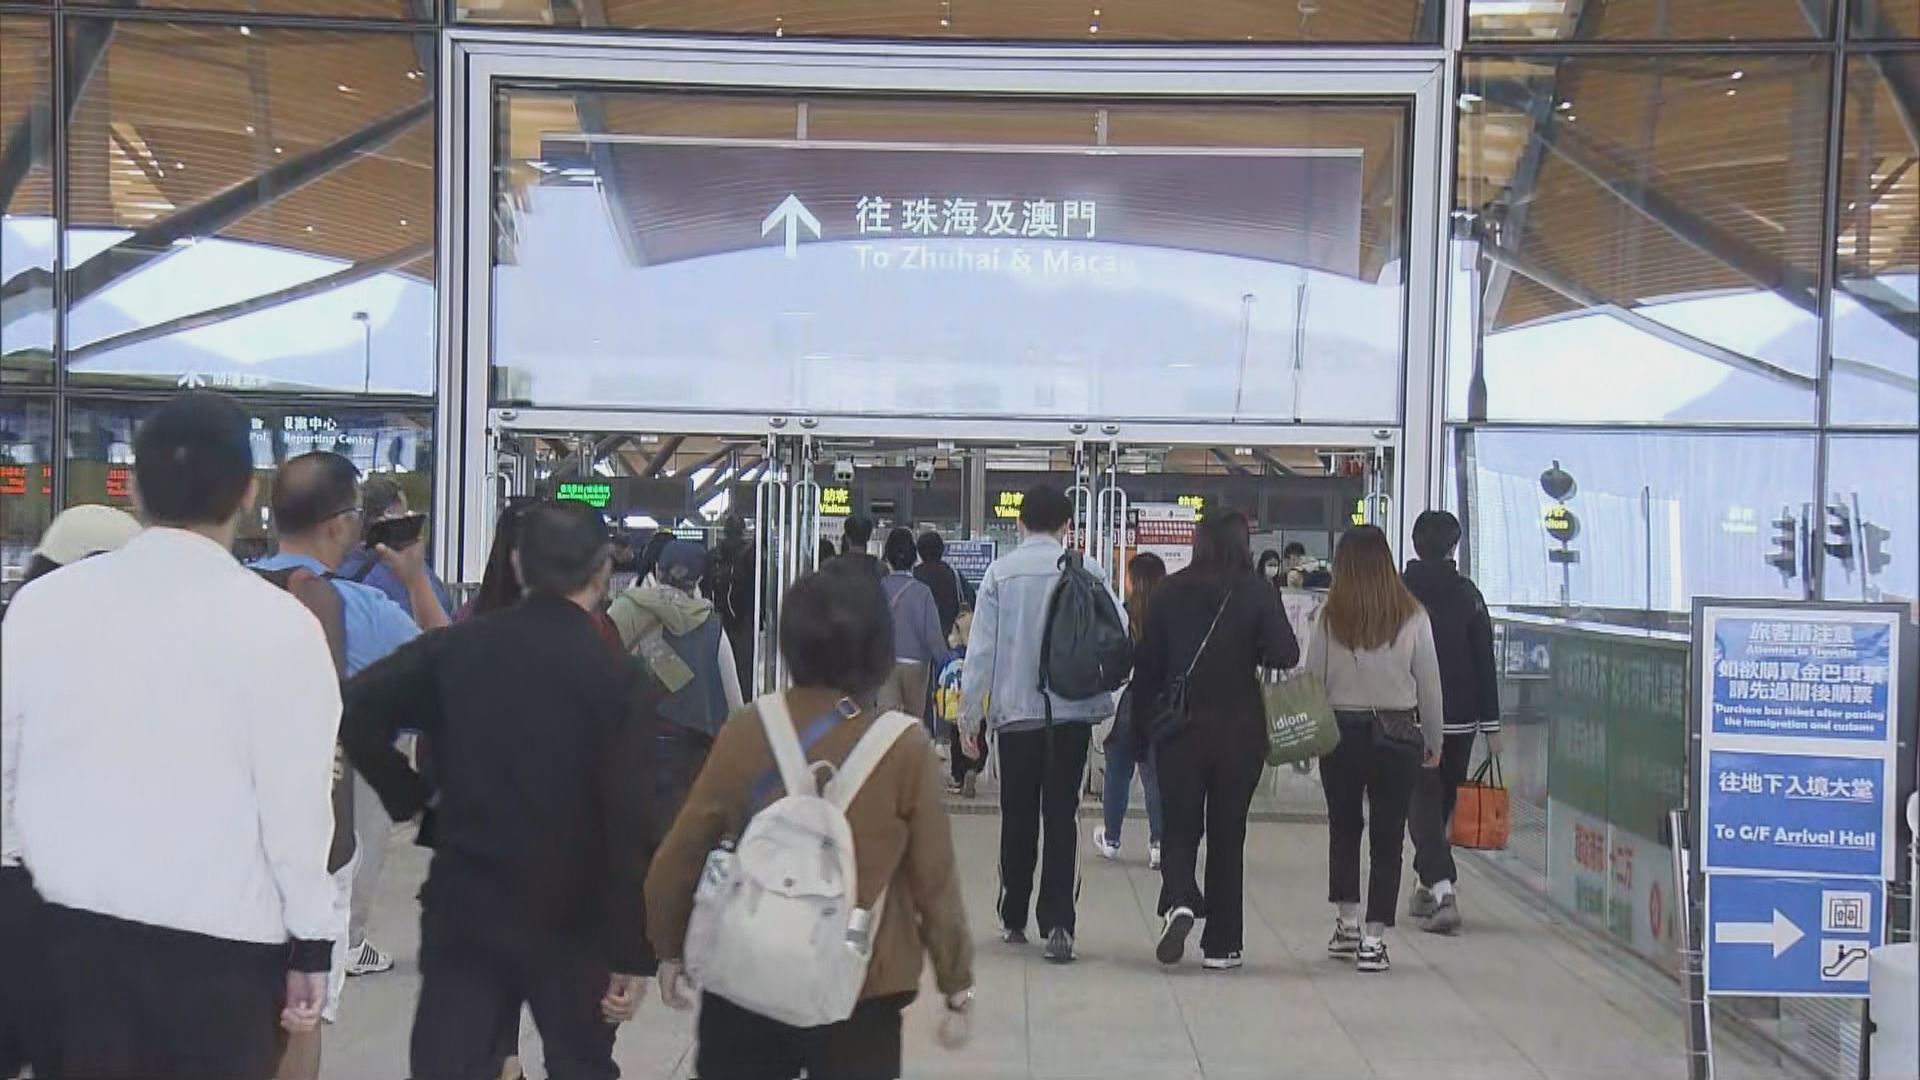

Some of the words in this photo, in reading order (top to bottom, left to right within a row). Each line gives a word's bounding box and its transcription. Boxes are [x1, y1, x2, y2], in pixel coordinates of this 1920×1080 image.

[855, 195, 1097, 239] 往珠海及澳門
[856, 245, 890, 270] To
[901, 245, 999, 271] Zhuhai
[1009, 248, 1032, 273] &
[1043, 249, 1136, 274] Macau
[339, 434, 375, 445] Centre
[1750, 622, 1854, 642] 旅客請注意
[1729, 680, 1873, 704] 請先過關後購票
[1269, 711, 1308, 731] idiom
[1715, 704, 1763, 715] Purchase
[1764, 705, 1782, 715] bus
[1784, 706, 1814, 717] ticket
[1816, 707, 1843, 718] after
[1844, 710, 1884, 721] passing
[1724, 716, 1742, 726] the
[1743, 717, 1808, 730] immigration
[1810, 719, 1831, 730] and
[1833, 721, 1875, 732] customs
[1719, 771, 1874, 797] 往地下入境大堂
[1714, 824, 1735, 840] To
[1739, 825, 1770, 842] G/F
[1773, 828, 1835, 845] Arrival
[1839, 831, 1876, 847] Hall
